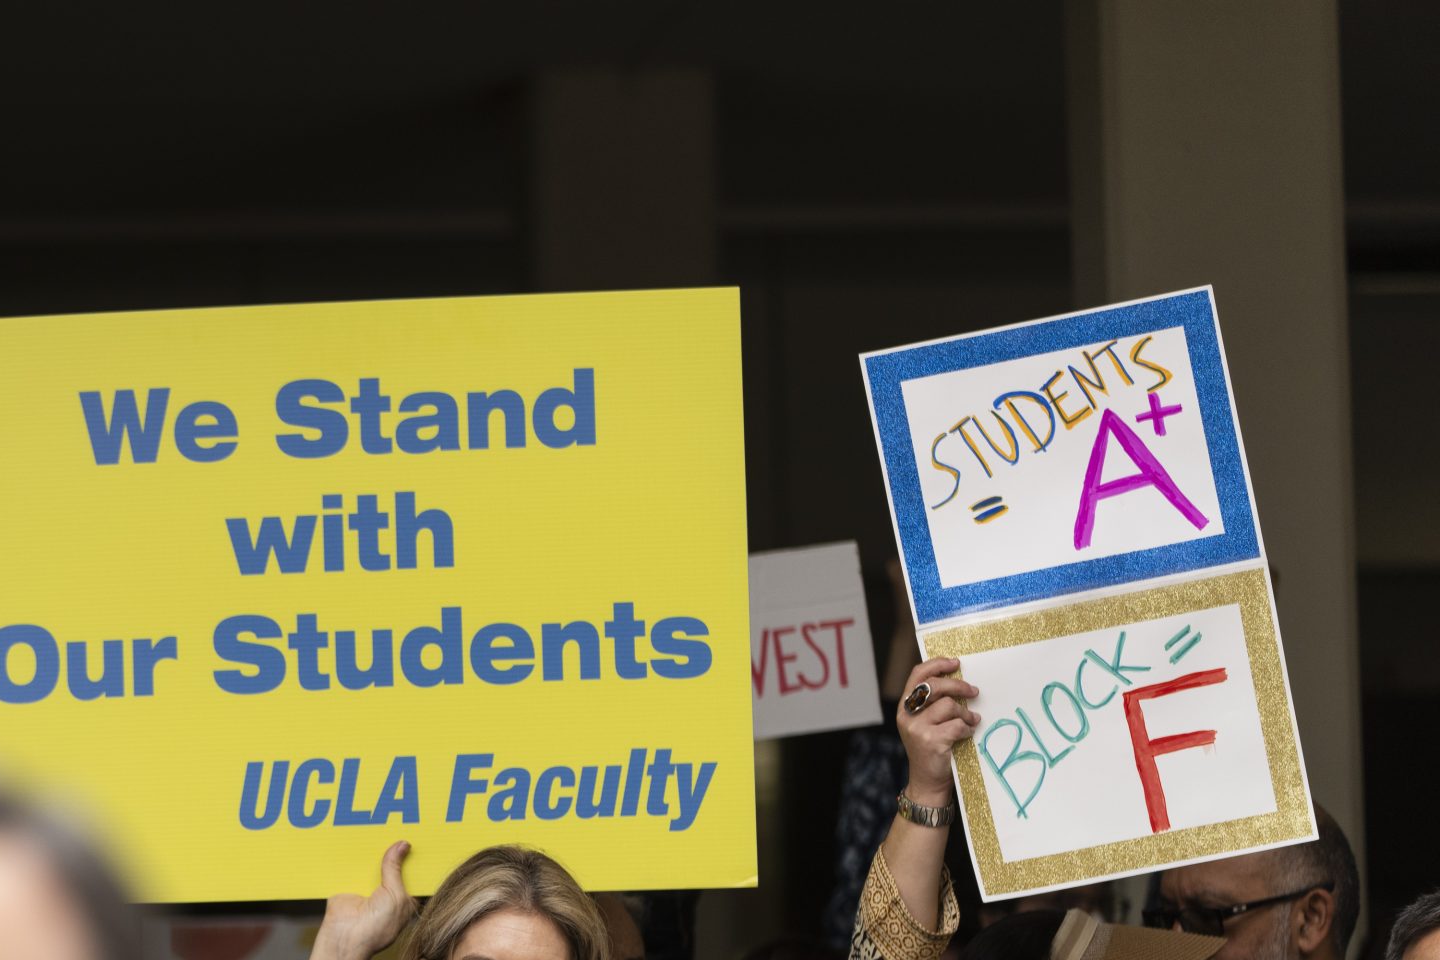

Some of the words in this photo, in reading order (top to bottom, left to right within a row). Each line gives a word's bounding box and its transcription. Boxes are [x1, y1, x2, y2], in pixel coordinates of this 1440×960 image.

[78, 386, 240, 467] We
[274, 366, 598, 459] Stand
[930, 335, 1174, 510] STUDENTS
[225, 490, 456, 577] with
[211, 600, 715, 696] Students
[978, 630, 1152, 819] BLOCK
[1122, 667, 1228, 834] F
[237, 754, 422, 831] UCLA
[444, 747, 719, 832] Faculty
